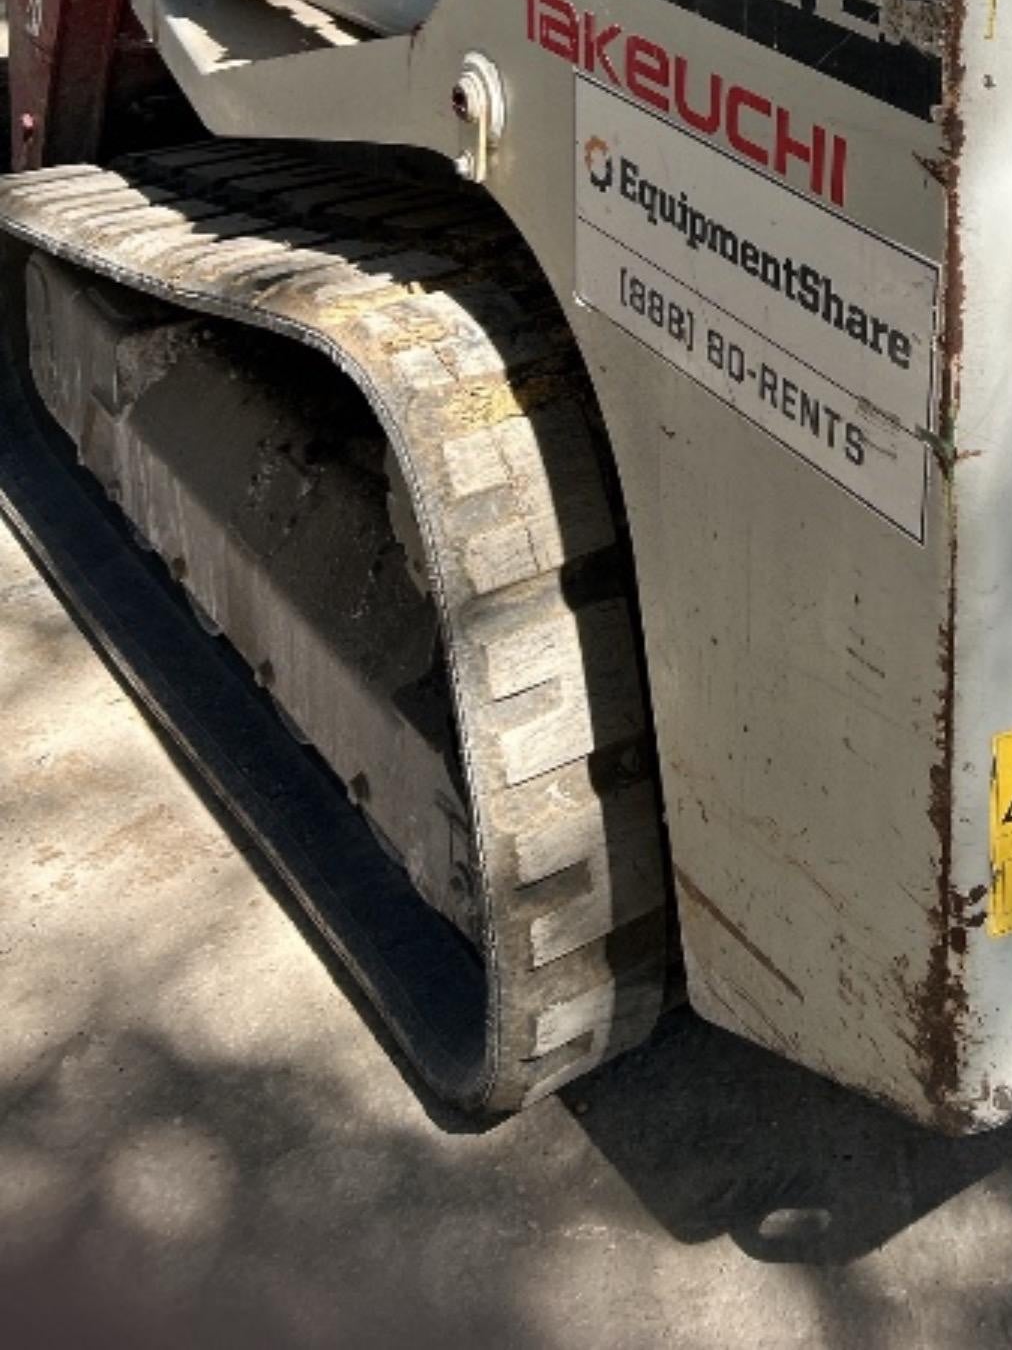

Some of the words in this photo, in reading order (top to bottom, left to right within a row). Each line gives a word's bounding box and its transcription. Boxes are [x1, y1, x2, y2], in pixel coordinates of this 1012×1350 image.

[619, 155, 912, 370] EquipmentShare
[619, 266, 695, 352] (888)
[707, 328, 866, 467] 80-RENTS
